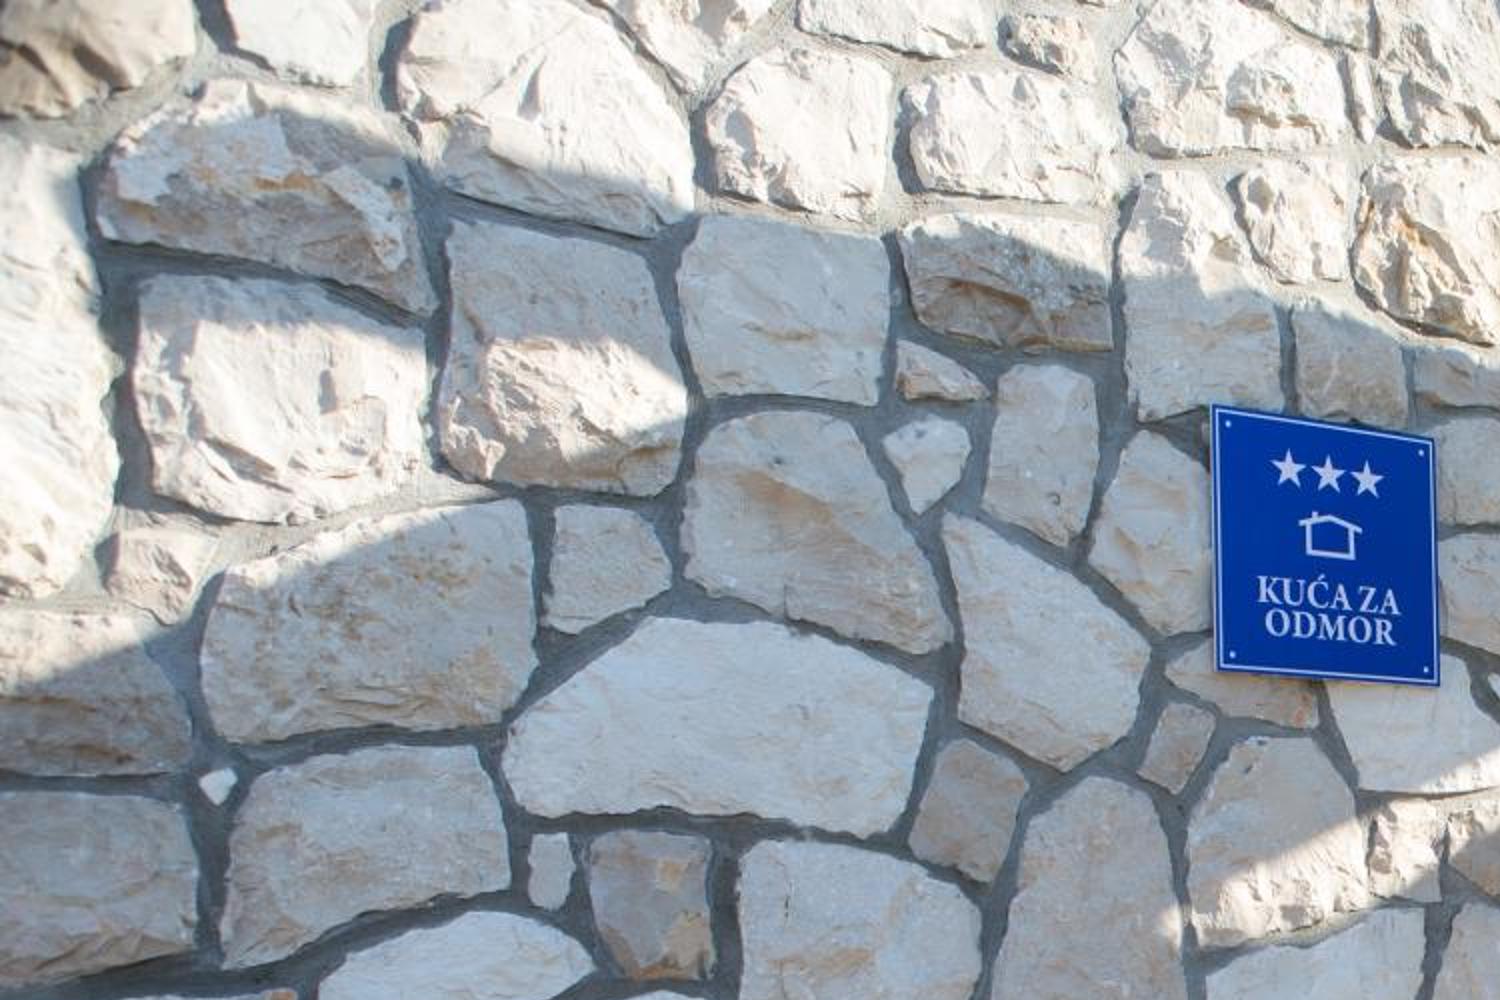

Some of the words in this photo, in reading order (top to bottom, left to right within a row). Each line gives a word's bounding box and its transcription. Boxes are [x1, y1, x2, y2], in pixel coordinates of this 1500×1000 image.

[1257, 574, 1352, 611] KUĆA
[1358, 586, 1401, 615] ZA
[1265, 608, 1397, 646] ODMOR
